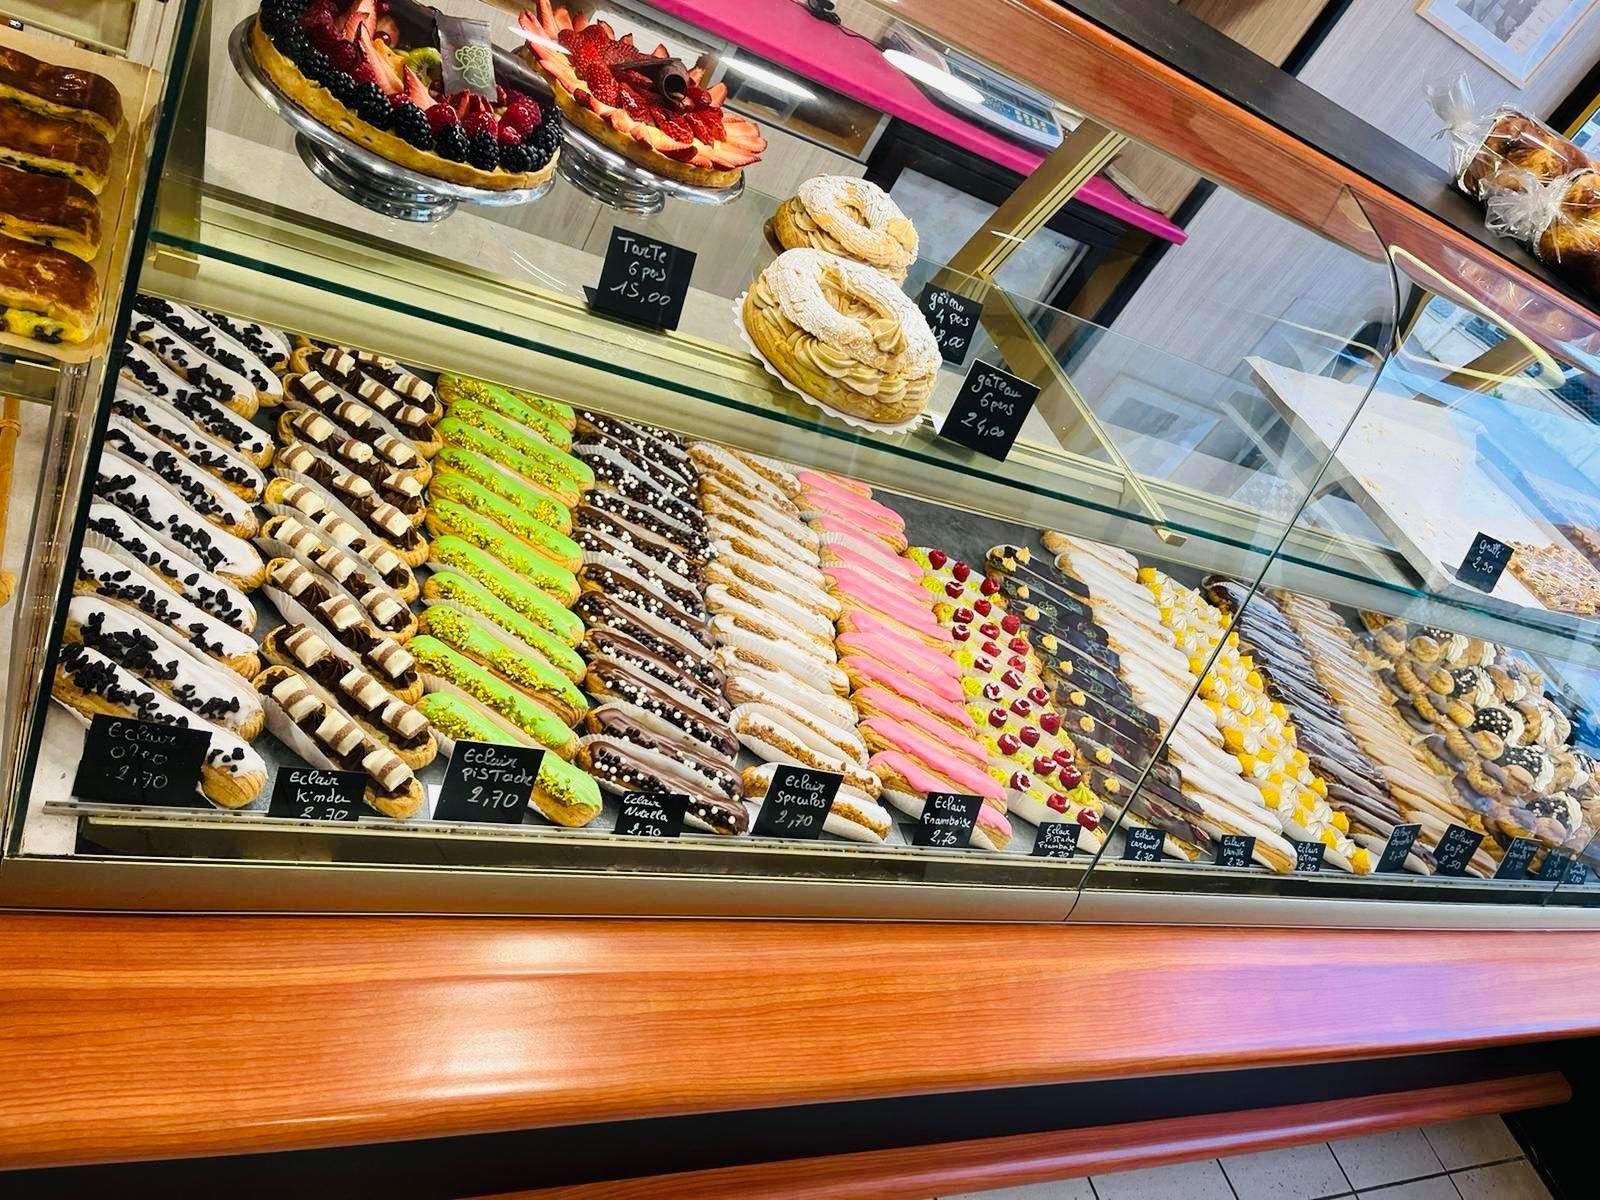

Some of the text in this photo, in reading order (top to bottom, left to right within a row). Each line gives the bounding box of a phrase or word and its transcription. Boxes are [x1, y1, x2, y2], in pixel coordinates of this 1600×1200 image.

[629, 261, 640, 275] 6
[609, 281, 671, 305] 15,00
[961, 412, 1005, 437] 24,00
[464, 748, 518, 768] Eclair
[115, 765, 168, 789] 2,70
[785, 773, 825, 793] Eclair
[467, 785, 519, 809] 2,70
[623, 793, 662, 808] Eclair
[935, 795, 966, 813] Eclair
[624, 806, 668, 823] Nutella
[775, 809, 813, 829] 2,70
[930, 829, 957, 846] 2,70
